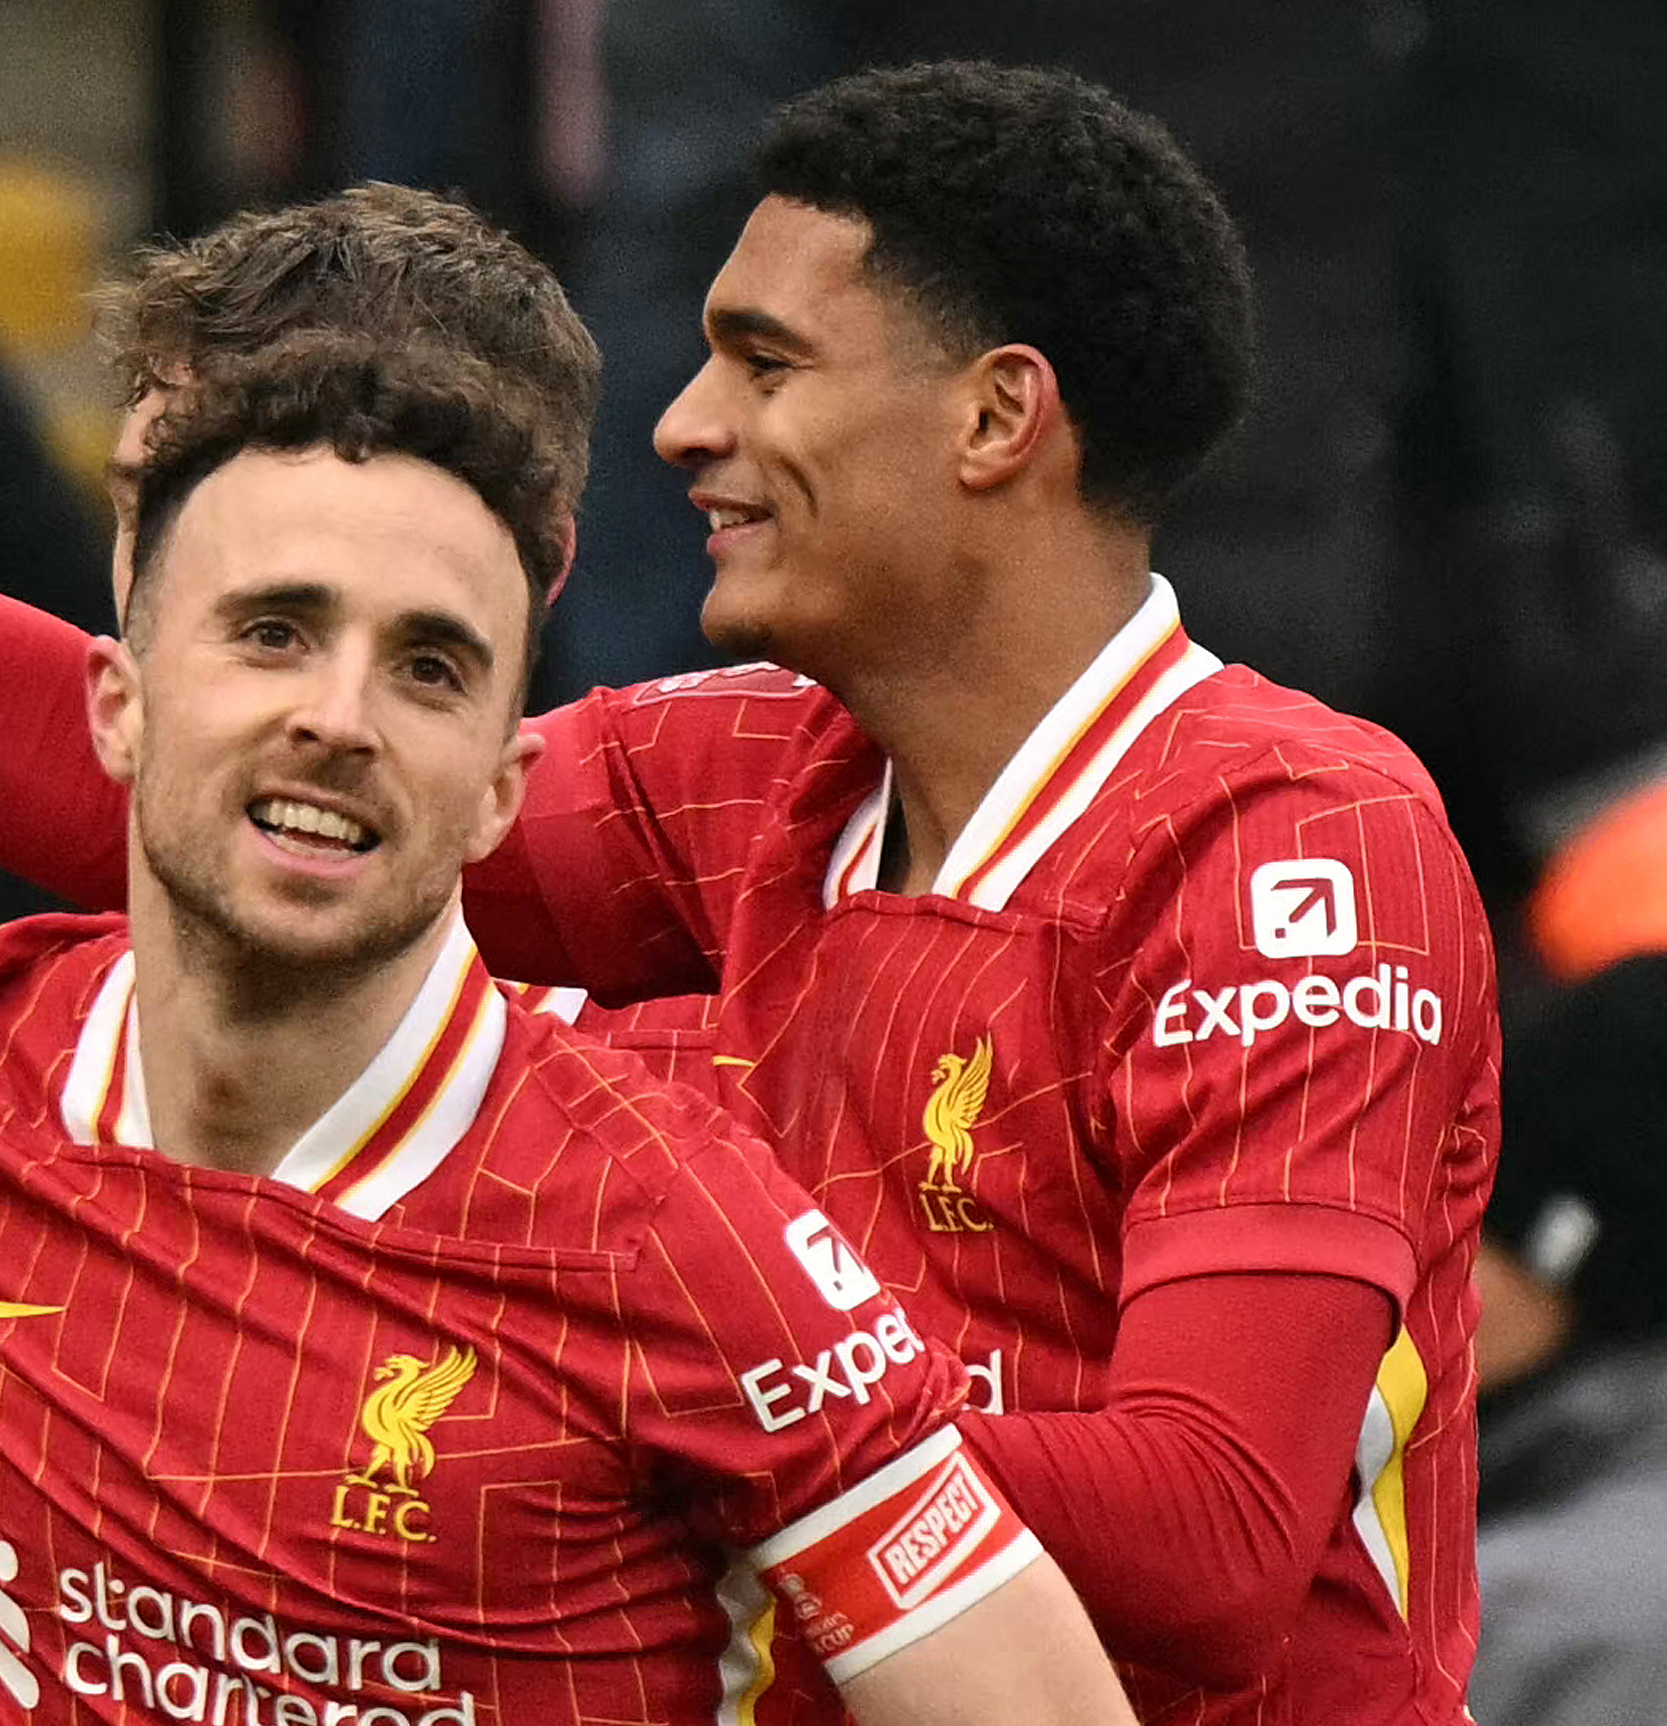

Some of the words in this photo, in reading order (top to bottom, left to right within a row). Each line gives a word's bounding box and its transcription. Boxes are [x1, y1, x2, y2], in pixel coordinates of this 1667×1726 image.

[1153, 963, 1442, 1047] Expedia
[331, 1485, 437, 1542] L.F.C.
[883, 1471, 979, 1586] RESPECT
[59, 1562, 442, 1692] standard
